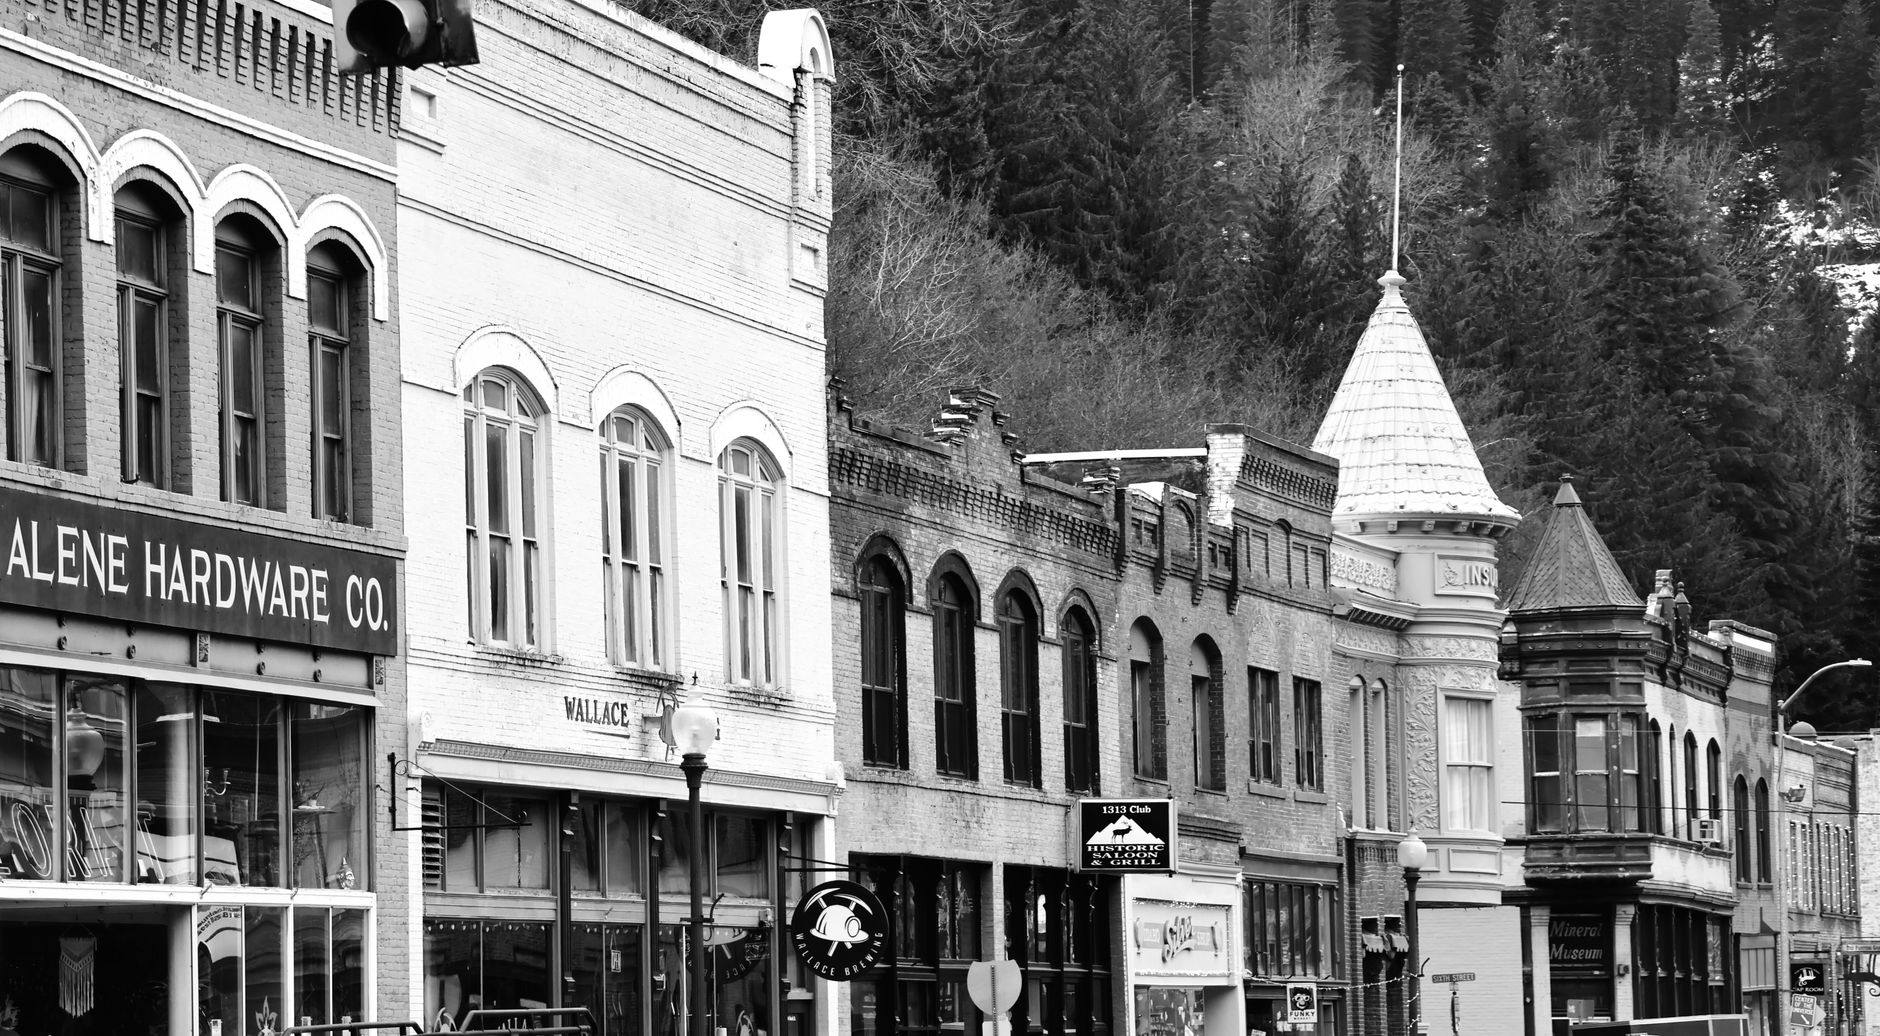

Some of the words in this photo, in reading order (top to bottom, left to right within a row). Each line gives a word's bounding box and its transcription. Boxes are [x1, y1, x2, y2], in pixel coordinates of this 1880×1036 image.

[7, 517, 130, 596] ALENE
[145, 541, 331, 624] HARDWARE
[346, 574, 389, 632] CO.
[564, 696, 630, 728] WALLACE
[1102, 805, 1127, 814] 1313
[1129, 805, 1152, 814] Club
[1550, 921, 1602, 937] Mineral
[796, 932, 835, 976] WALLACE
[844, 932, 884, 976] BREWING
[1550, 944, 1602, 959] Museum
